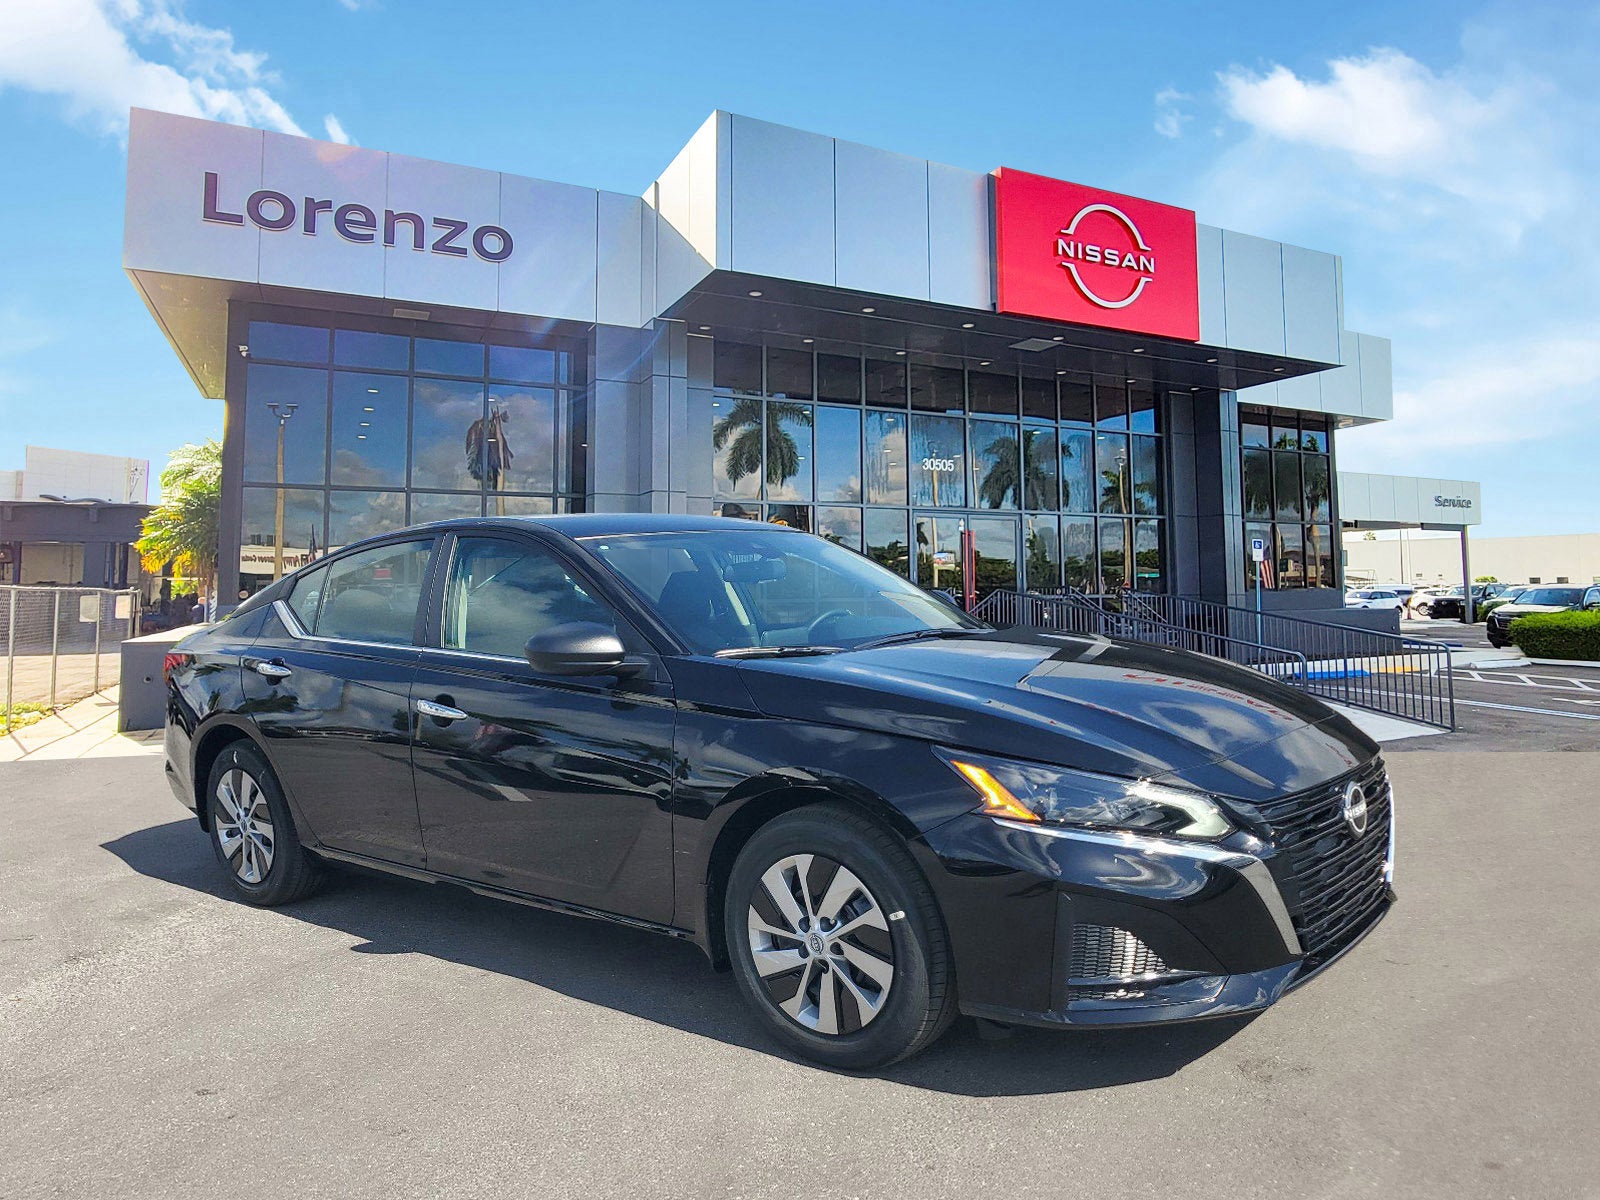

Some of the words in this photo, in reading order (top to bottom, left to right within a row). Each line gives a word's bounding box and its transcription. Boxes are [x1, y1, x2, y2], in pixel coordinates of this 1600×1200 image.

[202, 171, 514, 262] Lorenzo
[1057, 238, 1155, 273] NISSAN
[922, 457, 954, 471] 30505
[1434, 495, 1472, 508] Service
